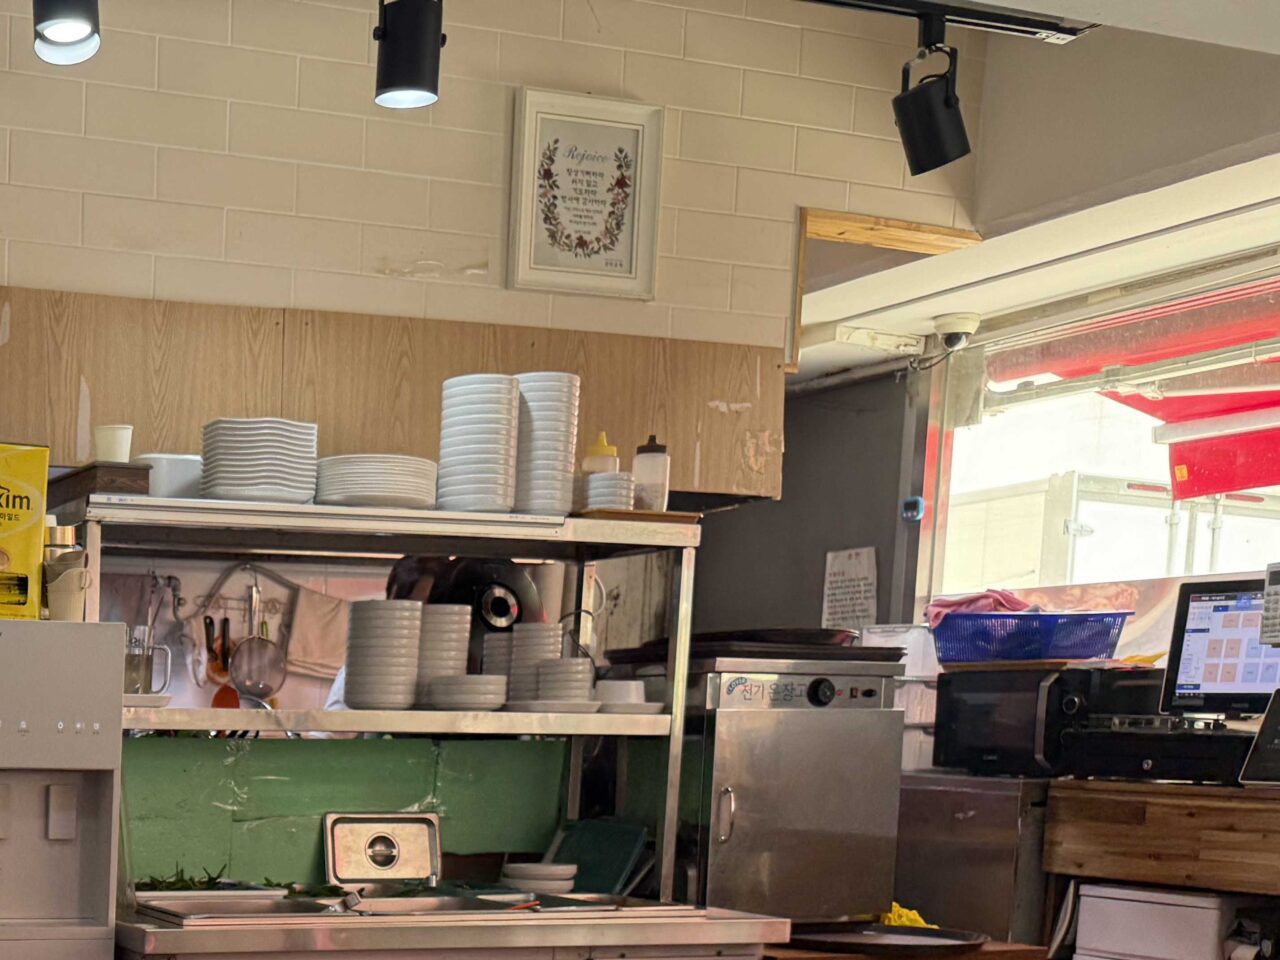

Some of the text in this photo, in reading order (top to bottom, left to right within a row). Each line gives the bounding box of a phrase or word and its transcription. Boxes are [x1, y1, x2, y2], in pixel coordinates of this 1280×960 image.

[562, 145, 610, 167] Rejoice
[742, 681, 808, 702] 전기 온장고
